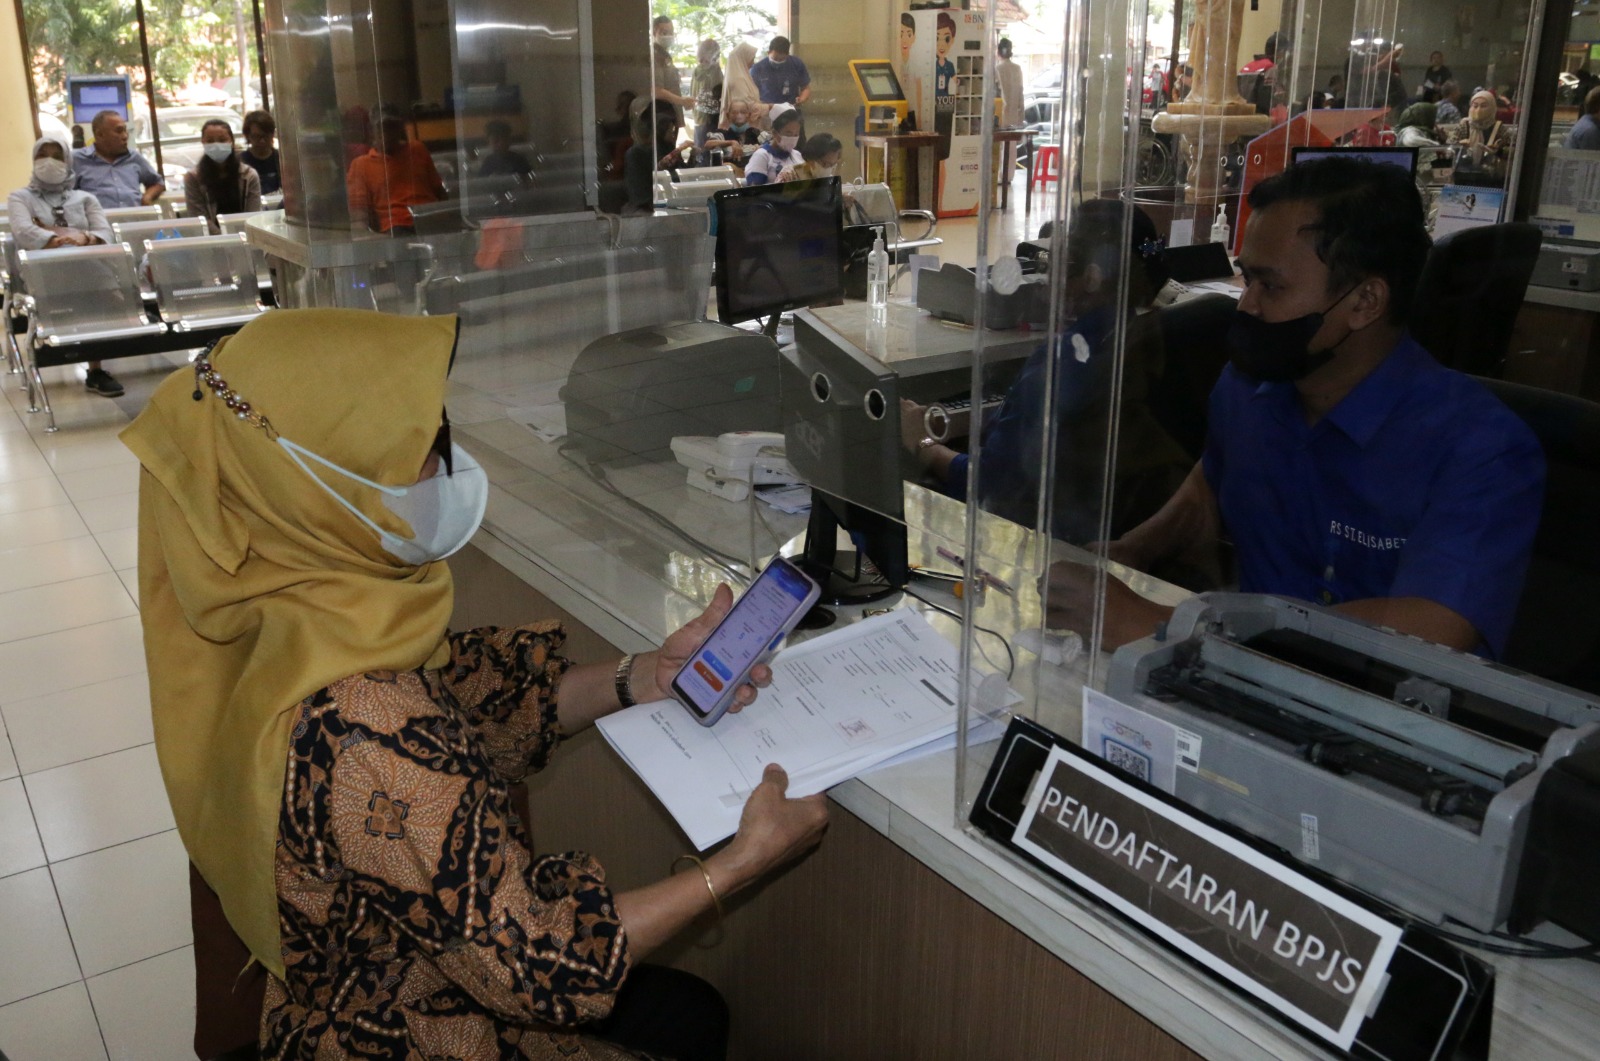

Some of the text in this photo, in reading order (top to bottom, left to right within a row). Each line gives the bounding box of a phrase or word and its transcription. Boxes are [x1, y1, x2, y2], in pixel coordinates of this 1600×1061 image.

[972, 14, 985, 24] BN
[937, 96, 954, 105] YOU
[1330, 520, 1342, 535] RS
[1040, 786, 1362, 995] PENDAFTARAN BPJS
